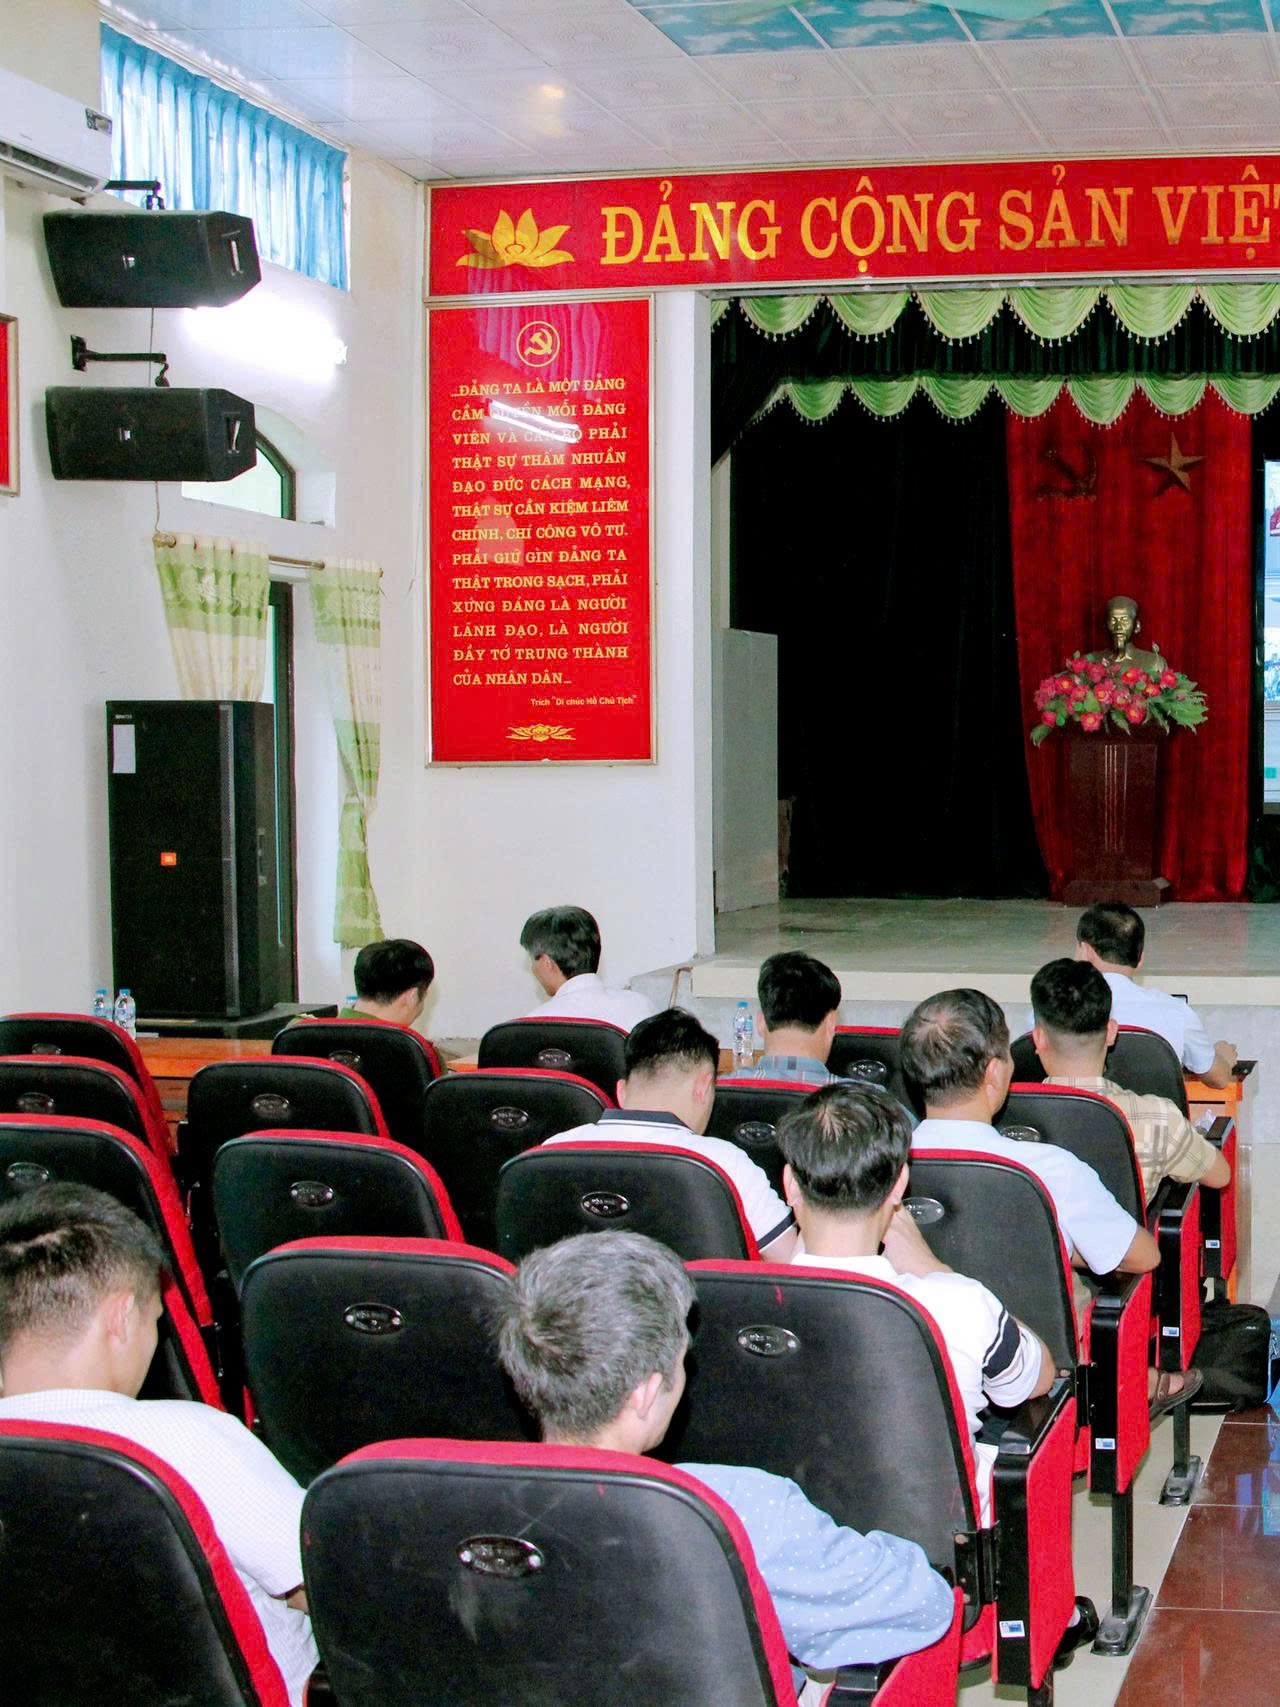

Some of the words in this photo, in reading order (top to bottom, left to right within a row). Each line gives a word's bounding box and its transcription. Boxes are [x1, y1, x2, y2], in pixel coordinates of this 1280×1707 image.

[600, 179, 782, 265] ĐẢNG
[801, 174, 981, 273] CỘNG
[999, 164, 1133, 251] SẢN
[503, 383, 521, 394] TA
[526, 377, 544, 393] LÀ
[549, 377, 579, 395] MỘT
[583, 373, 625, 390] ĐẢNG
[549, 400, 576, 416] MỖI
[583, 400, 626, 415] ĐẢNG
[453, 429, 490, 445] VIÊN
[589, 422, 627, 439] PHẢI
[453, 454, 492, 472] THẬT
[497, 454, 516, 471] SỰ
[453, 481, 485, 495] ĐẠO
[493, 476, 524, 491] ĐỨC
[531, 475, 572, 490] CÁCH
[453, 502, 490, 519] THẬT
[494, 503, 512, 517] SỰ
[549, 499, 588, 516] KIỆM
[592, 497, 629, 512] LIÊM
[506, 525, 531, 539] CHÍ
[536, 524, 576, 539] CÔNG
[580, 522, 601, 538] VÔ
[453, 549, 488, 565] PHẢI
[525, 547, 552, 563] GÌN
[559, 545, 601, 562] ĐẢNG
[607, 550, 627, 560] TA
[453, 575, 489, 591] THẬT
[494, 576, 544, 588] TRONG
[592, 568, 627, 584] PHẢI
[453, 597, 495, 612] XỨNG
[502, 596, 545, 611] ĐÁNG
[551, 595, 570, 611] LÀ
[577, 593, 626, 610] NGƯỜI
[453, 622, 496, 637] LÃNH
[549, 619, 568, 635] LÀ
[578, 617, 629, 634] NGƯỜI
[491, 644, 510, 660] TỚ
[515, 648, 568, 659] TRUNG
[573, 642, 629, 658] THÀNH
[453, 668, 482, 685] CỦA
[486, 669, 528, 685] NHÂN
